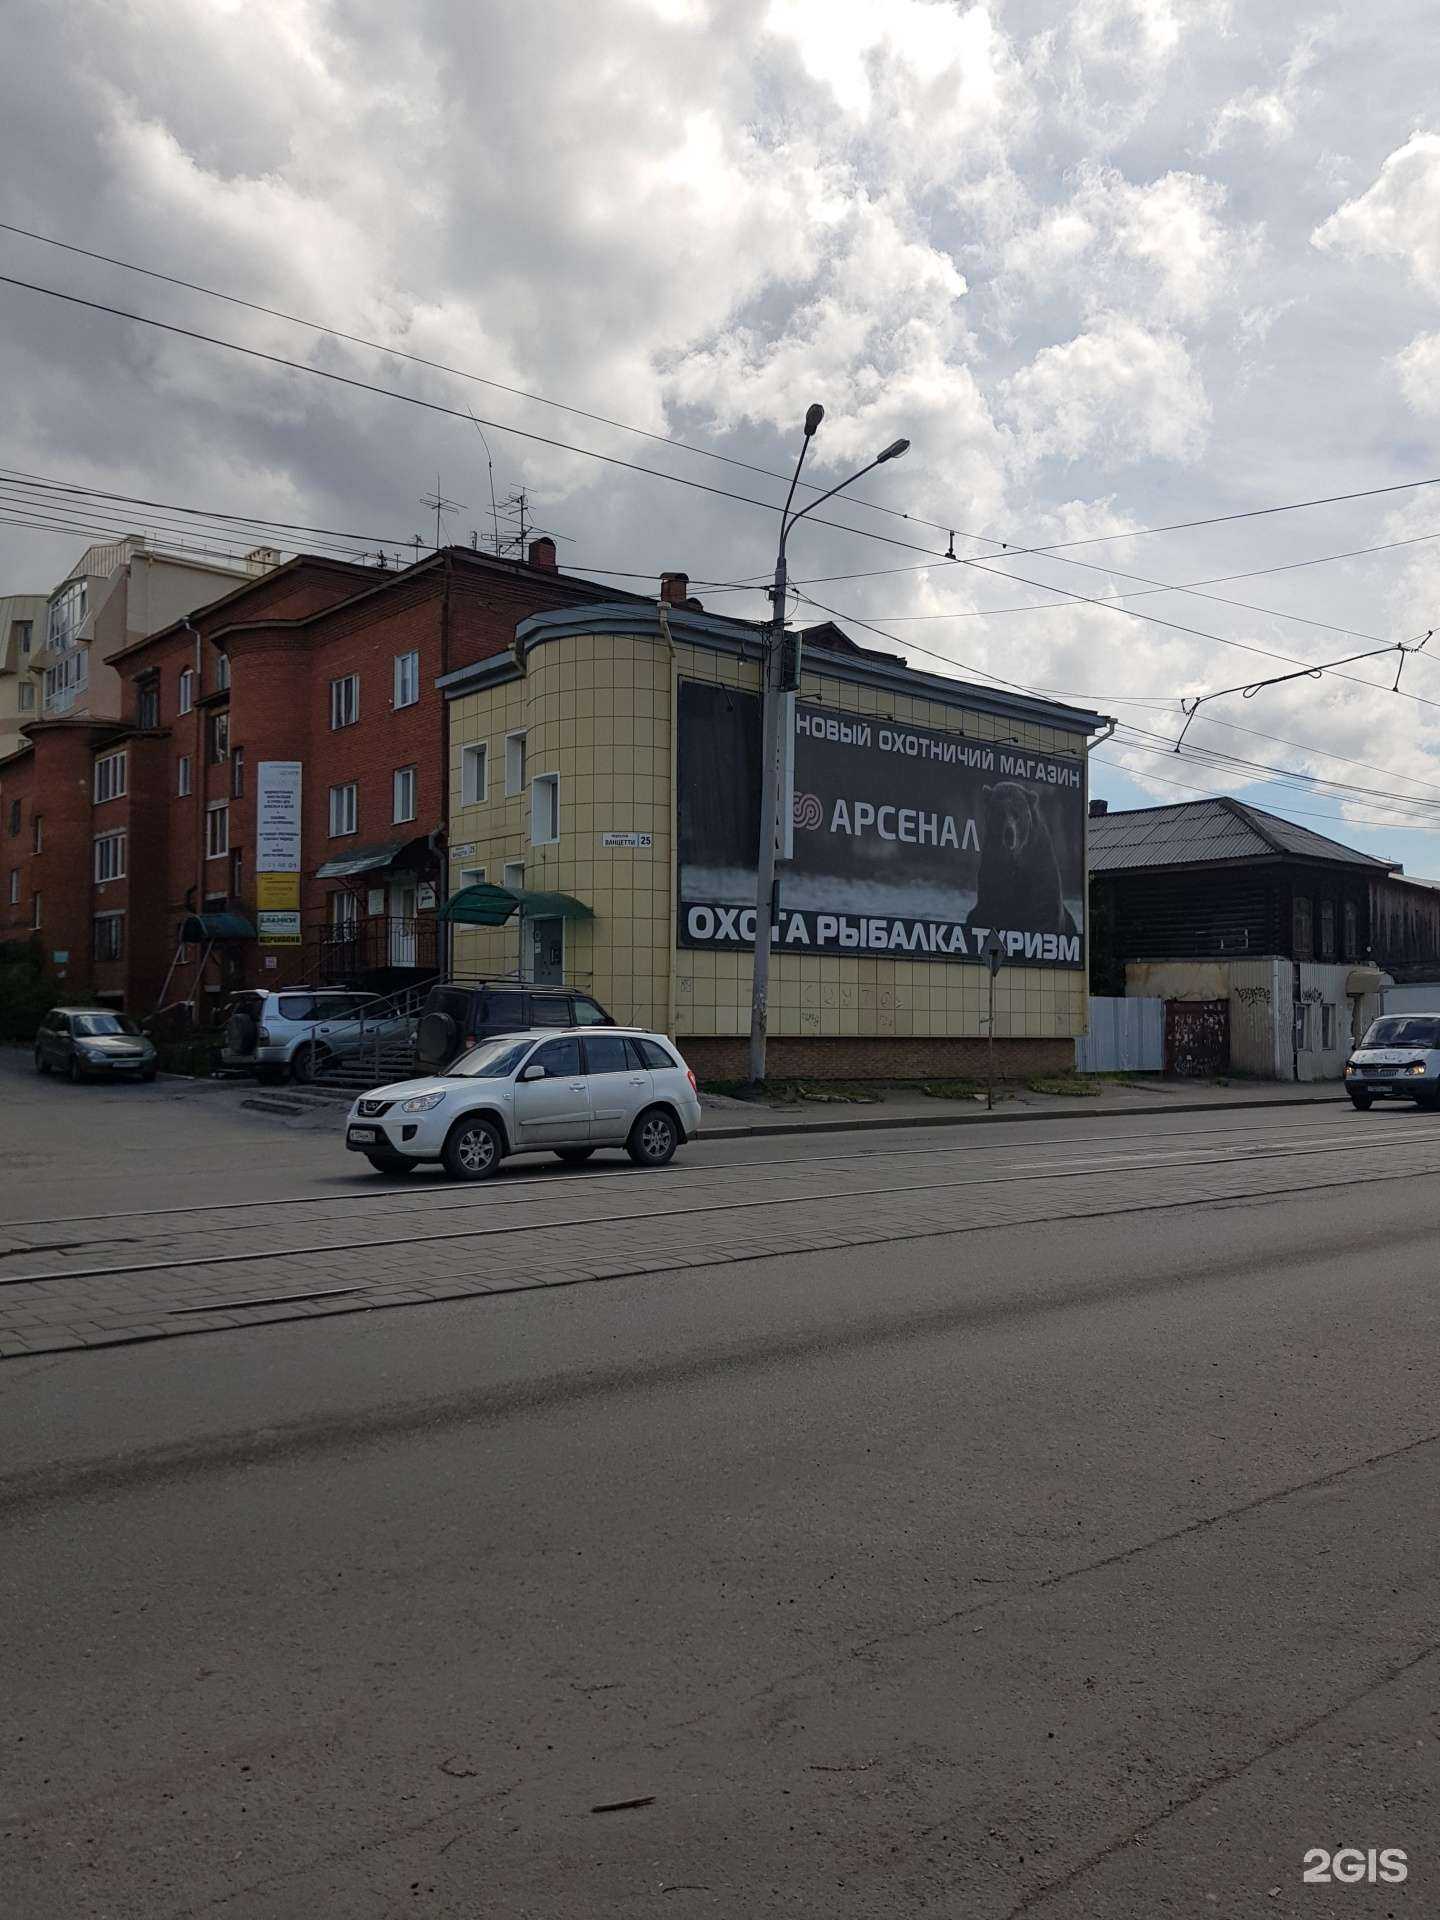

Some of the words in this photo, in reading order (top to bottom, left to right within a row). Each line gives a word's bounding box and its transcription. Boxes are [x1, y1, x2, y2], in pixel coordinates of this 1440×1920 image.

[796, 713, 871, 747] НОВЫЙ
[878, 729, 994, 771] ОХОТНИЧИЙ
[1000, 755, 1080, 788] МАГАЗИН
[640, 836, 651, 845] 25
[830, 799, 980, 852] АРСЕНАЛ
[817, 914, 968, 953] РЫБАЛКА
